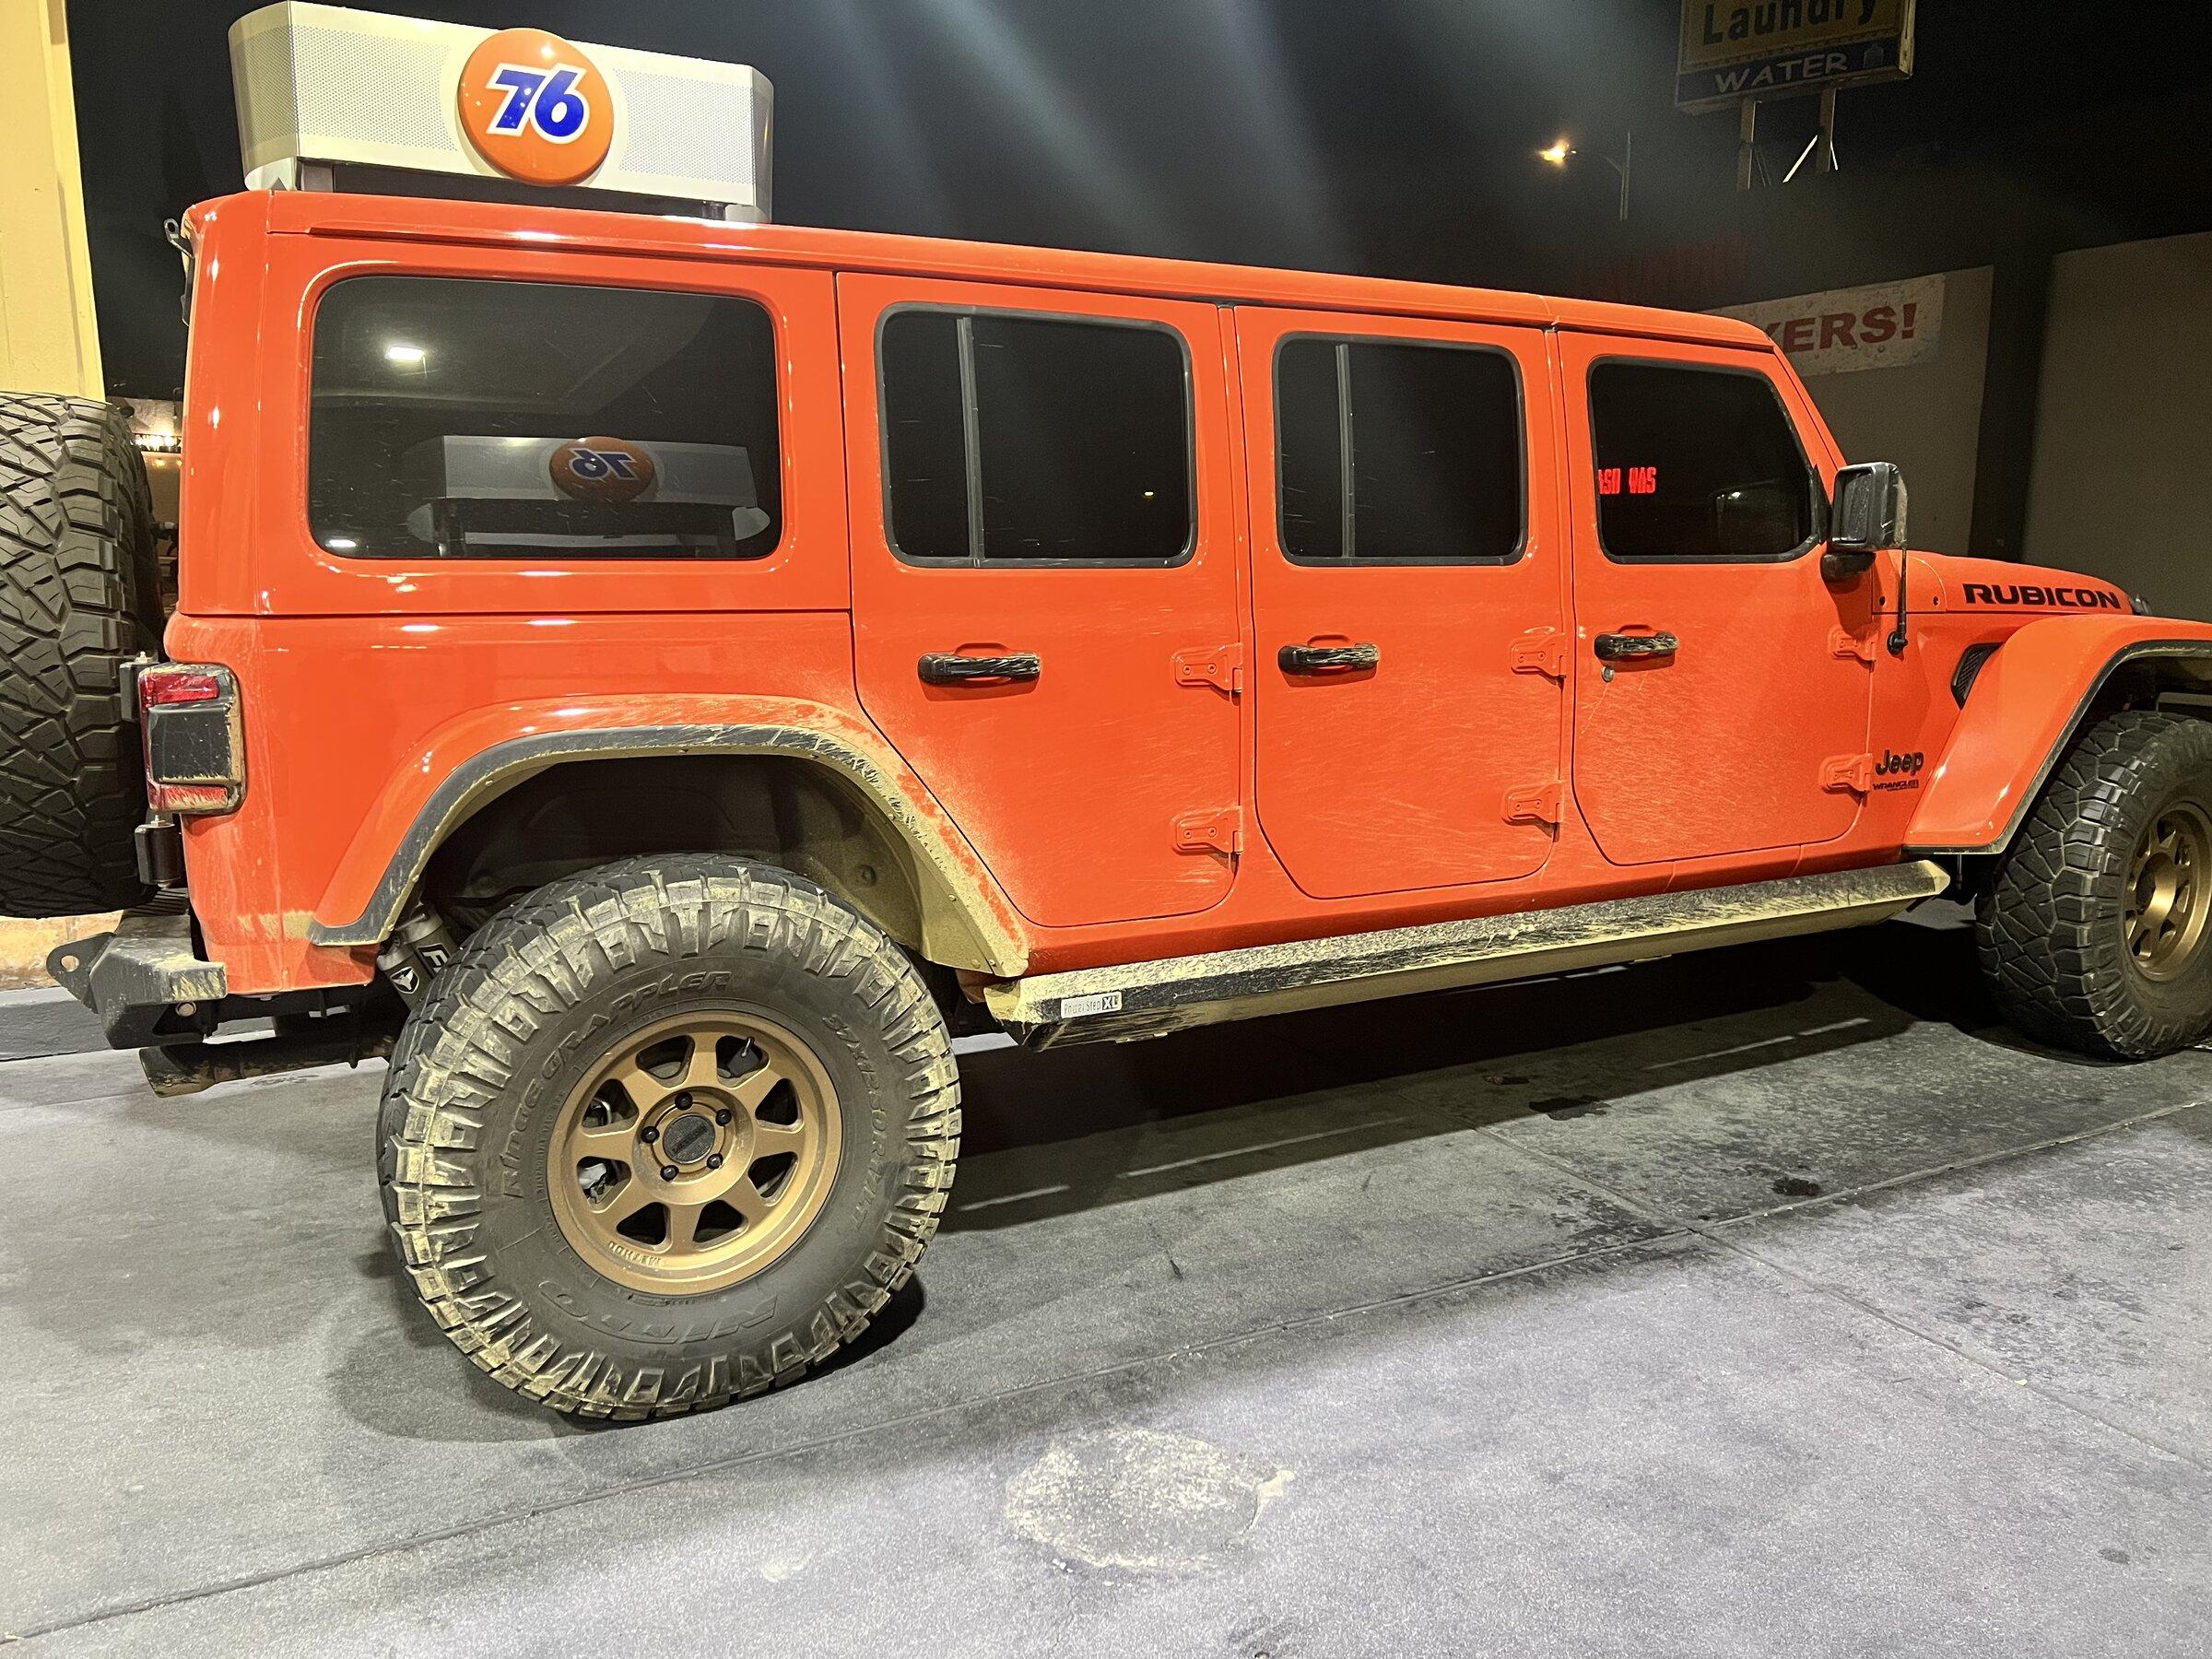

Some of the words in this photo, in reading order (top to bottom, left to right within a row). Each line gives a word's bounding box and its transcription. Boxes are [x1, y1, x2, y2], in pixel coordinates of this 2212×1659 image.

[1714, 52, 1848, 93] WATER
[489, 65, 588, 141] 76
[1962, 582, 2121, 609] RUBICON
[1875, 748, 1924, 776] Jeep
[1102, 995, 1119, 1010] XL
